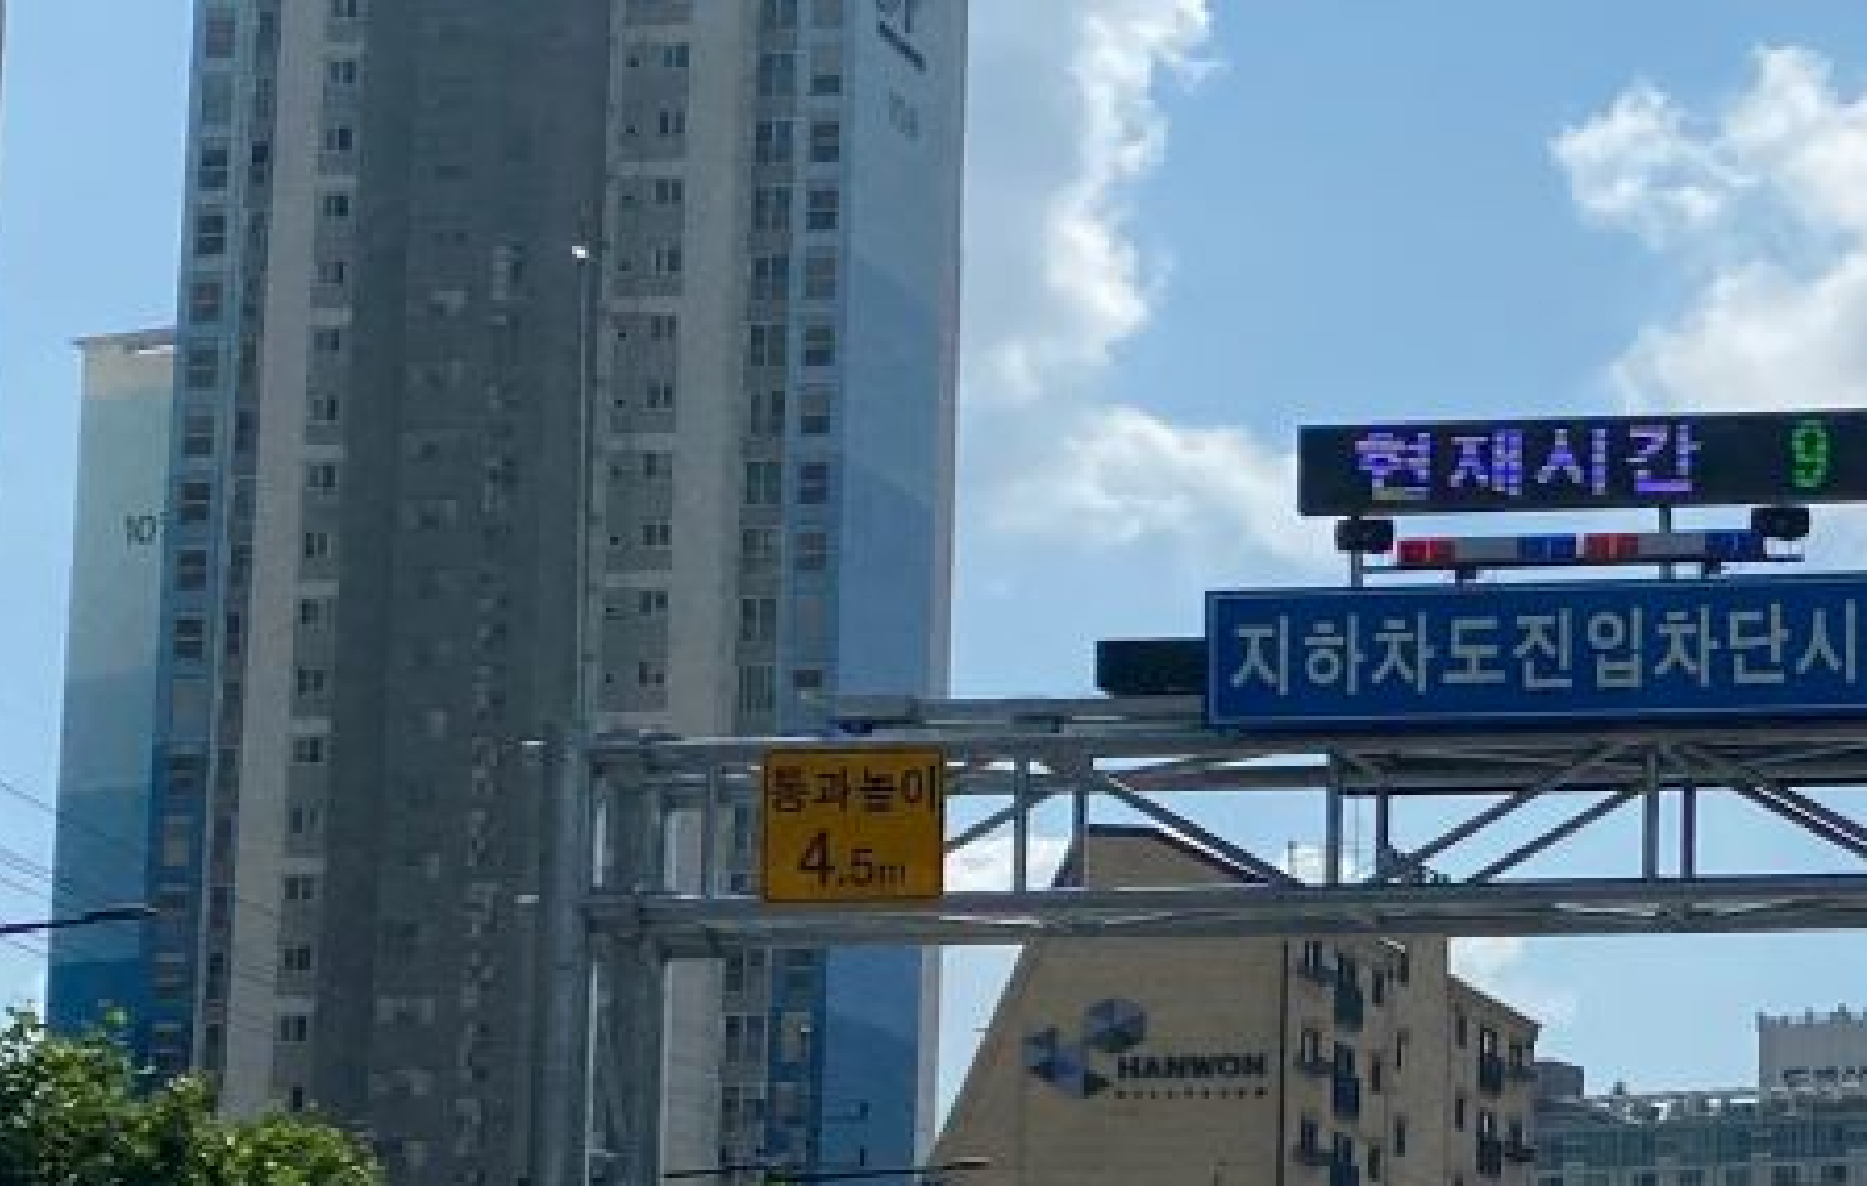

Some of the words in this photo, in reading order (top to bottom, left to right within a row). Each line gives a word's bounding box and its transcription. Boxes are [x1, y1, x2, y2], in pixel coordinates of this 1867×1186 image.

[1353, 424, 1701, 500] 현재시간
[1790, 420, 1830, 487] 9
[774, 764, 936, 813] 통과높이
